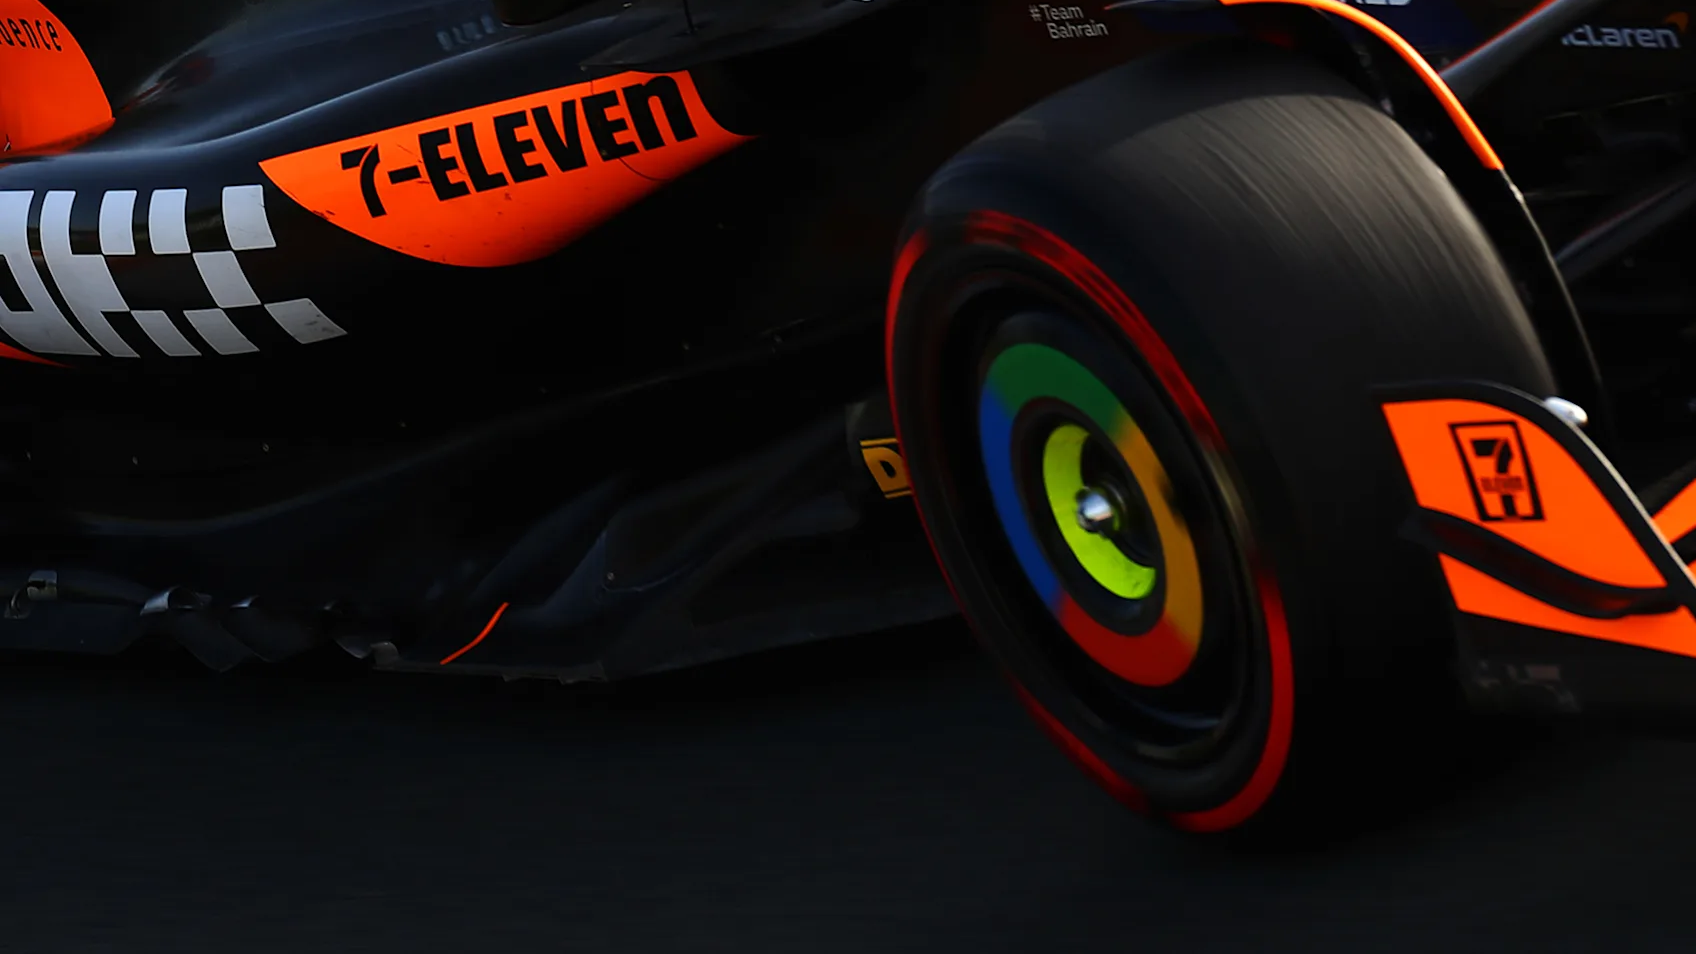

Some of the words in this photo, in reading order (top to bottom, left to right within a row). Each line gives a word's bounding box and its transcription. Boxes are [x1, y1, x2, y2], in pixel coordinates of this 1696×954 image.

[0, 17, 63, 52] uence
[1045, 19, 1110, 39] Bahrain
[1562, 21, 1681, 49] cLaren
[339, 74, 698, 219] 7-ELEVEN
